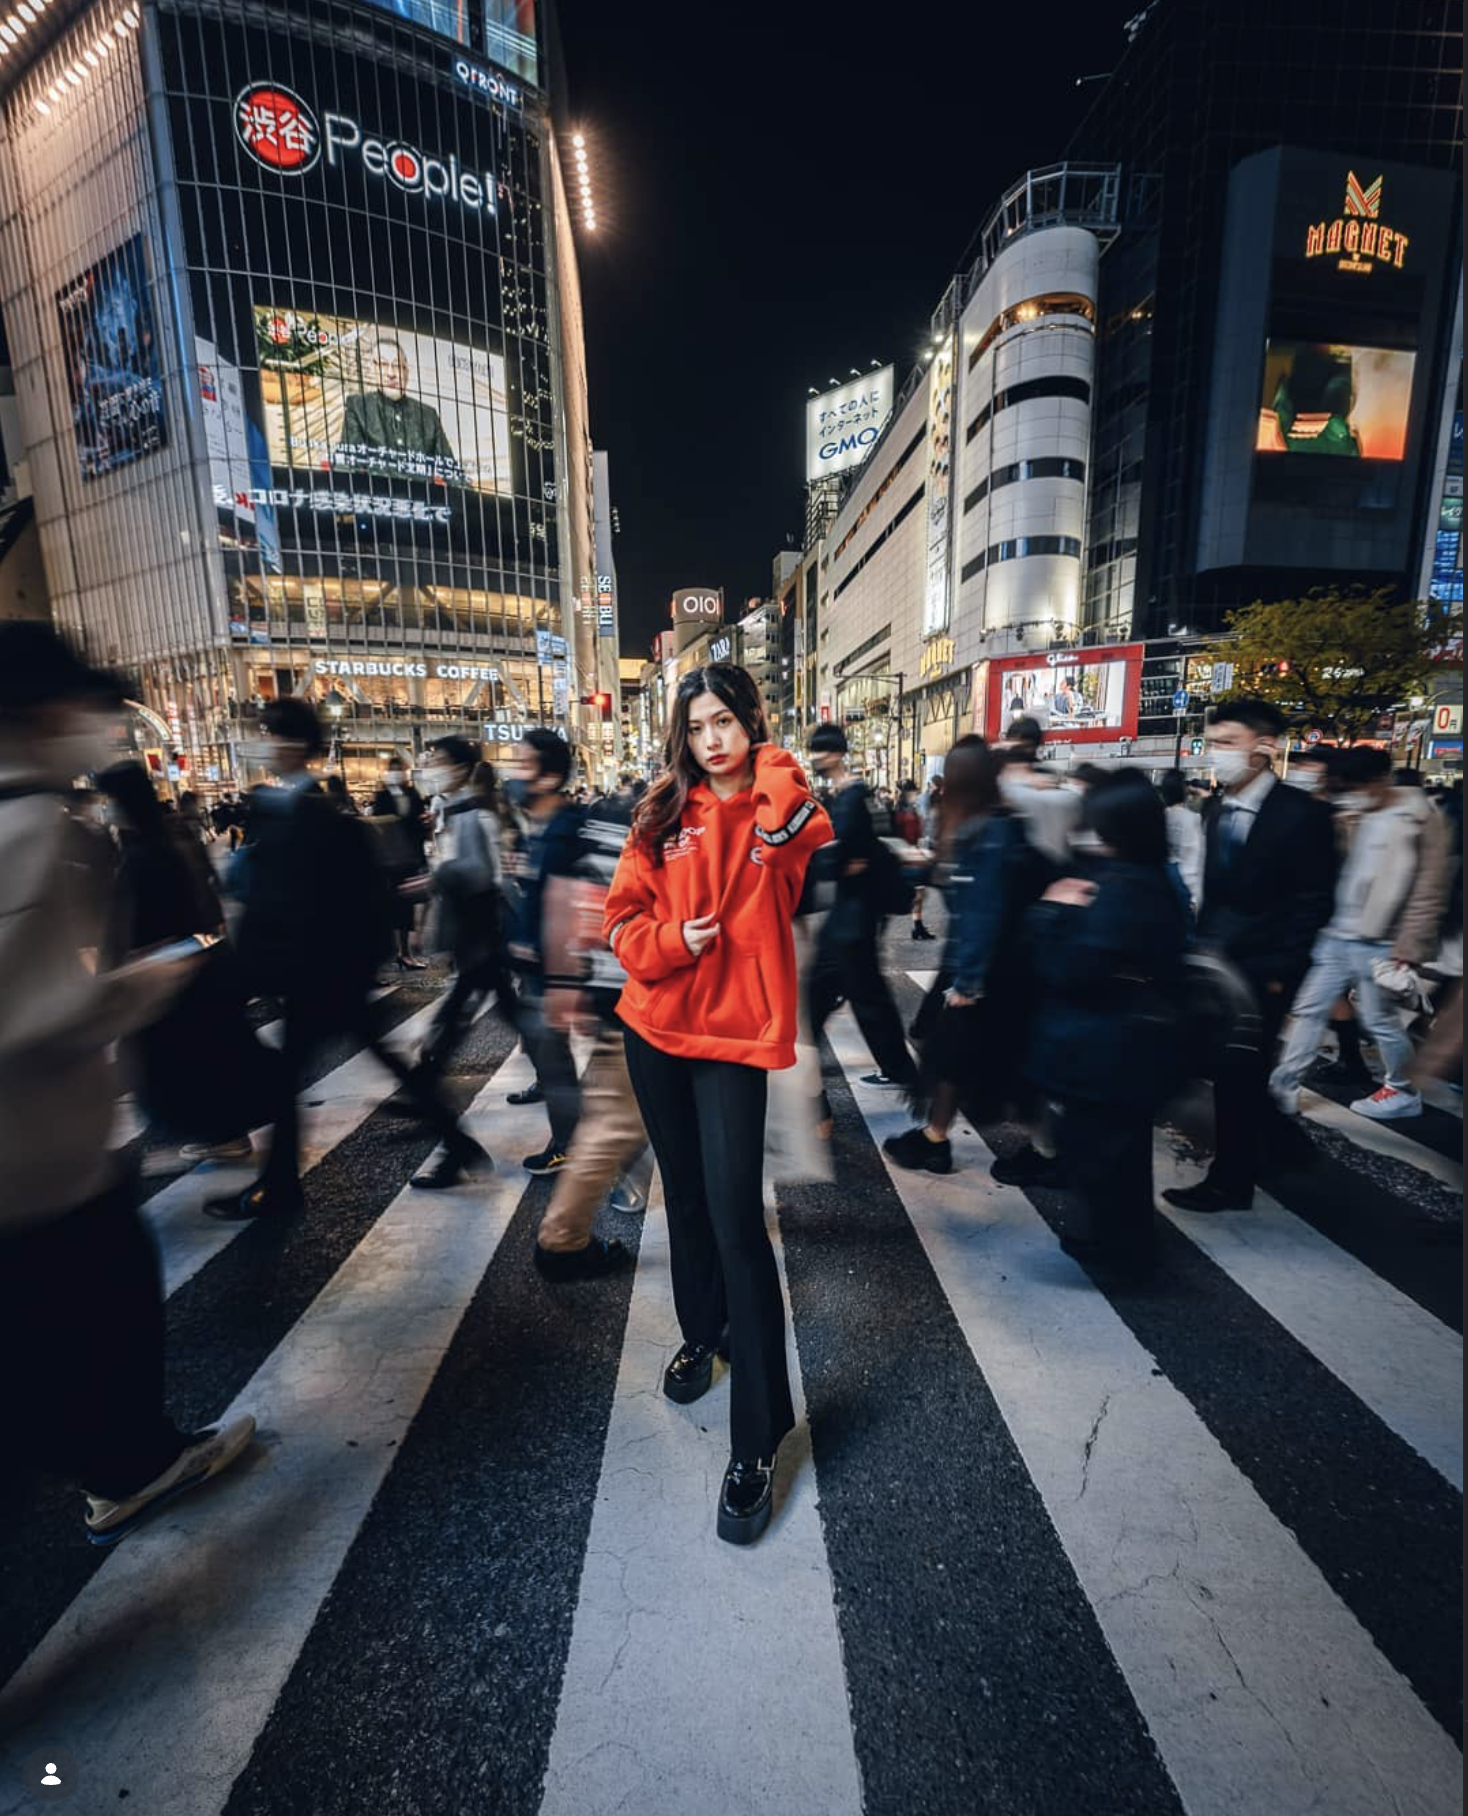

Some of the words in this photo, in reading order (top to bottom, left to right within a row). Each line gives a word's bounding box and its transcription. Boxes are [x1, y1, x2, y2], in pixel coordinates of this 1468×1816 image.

[455, 60, 518, 106] QFRONT
[239, 101, 318, 156] 渋谷
[323, 111, 497, 216] People!
[1306, 219, 1409, 269] MAGNET
[819, 427, 879, 459] GMO
[314, 660, 428, 677] STARBUCKS
[436, 664, 500, 682] COFFEE
